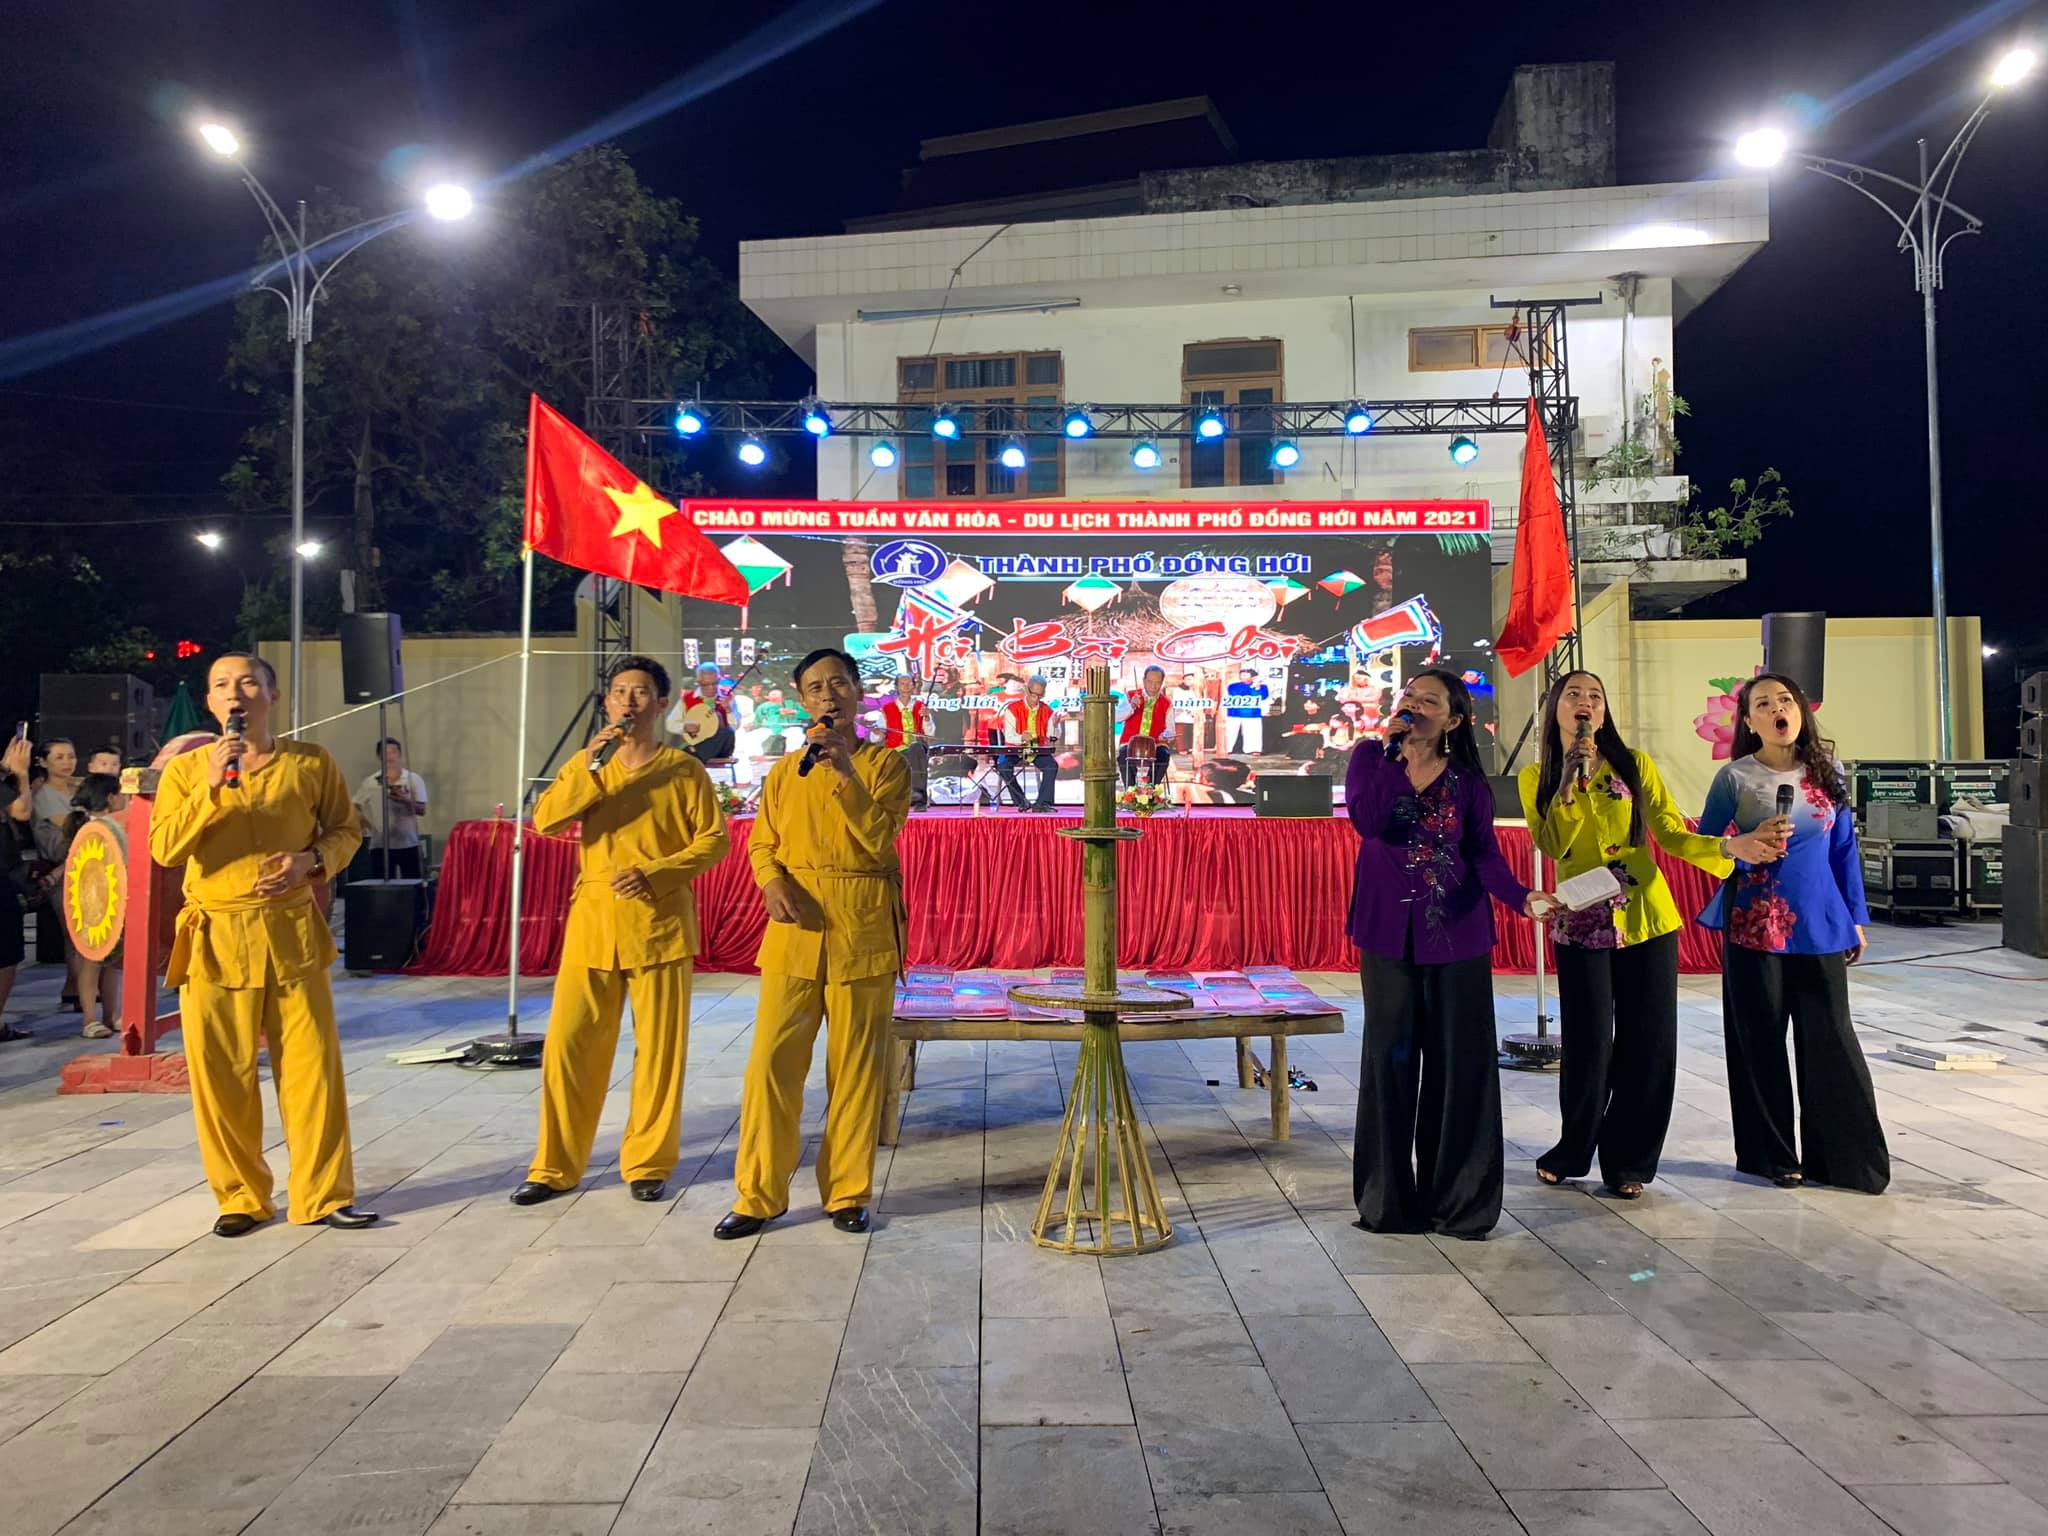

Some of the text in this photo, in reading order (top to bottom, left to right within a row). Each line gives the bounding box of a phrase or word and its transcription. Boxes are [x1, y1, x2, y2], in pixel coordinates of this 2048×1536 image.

[693, 508, 755, 527] CHÀO
[761, 508, 830, 527] MỪNG
[903, 509, 949, 528] VĂN
[955, 510, 1001, 528] HÓA
[1023, 512, 1054, 528] DU
[1060, 512, 1110, 531] LỊCH
[1116, 509, 1191, 528] THÀNH
[1197, 507, 1243, 528] PHỐ
[1318, 508, 1357, 527] HỚI
[1363, 508, 1417, 527] NĂM
[1423, 511, 1476, 527] 2021
[977, 551, 1312, 575] THÀNH PHỐ ĐỒNG HỚI
[1173, 697, 1213, 708] năm
[1222, 695, 1261, 708] 2021
